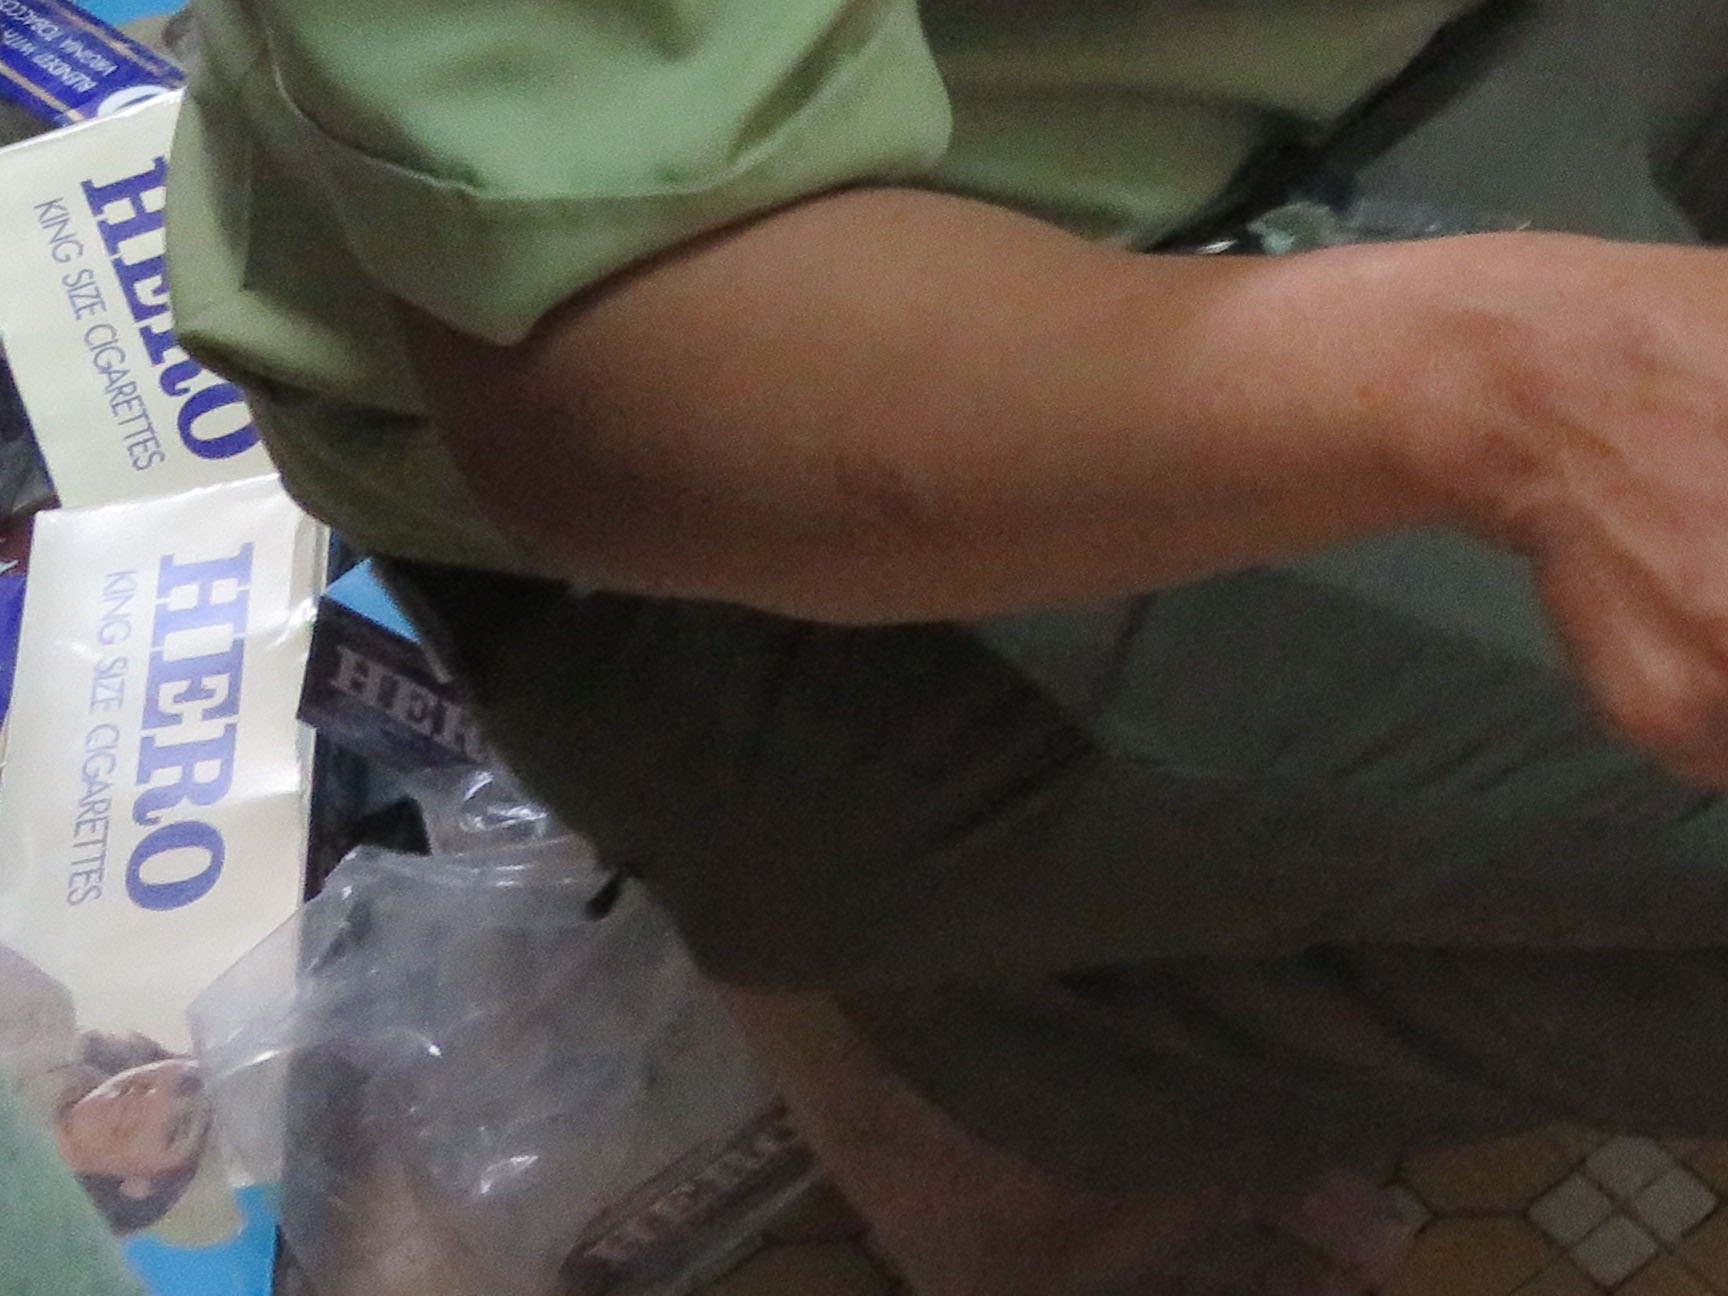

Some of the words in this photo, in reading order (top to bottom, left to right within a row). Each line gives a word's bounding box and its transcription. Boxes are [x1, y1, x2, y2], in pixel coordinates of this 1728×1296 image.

[34, 196, 85, 265] KING
[62, 268, 107, 322] SIZE
[84, 322, 166, 472] CIGARETTES
[96, 569, 139, 647] KING
[89, 651, 132, 714] SIZE
[125, 540, 255, 912] HERO
[330, 644, 489, 766] HER
[66, 724, 121, 908] CIGARETTES
